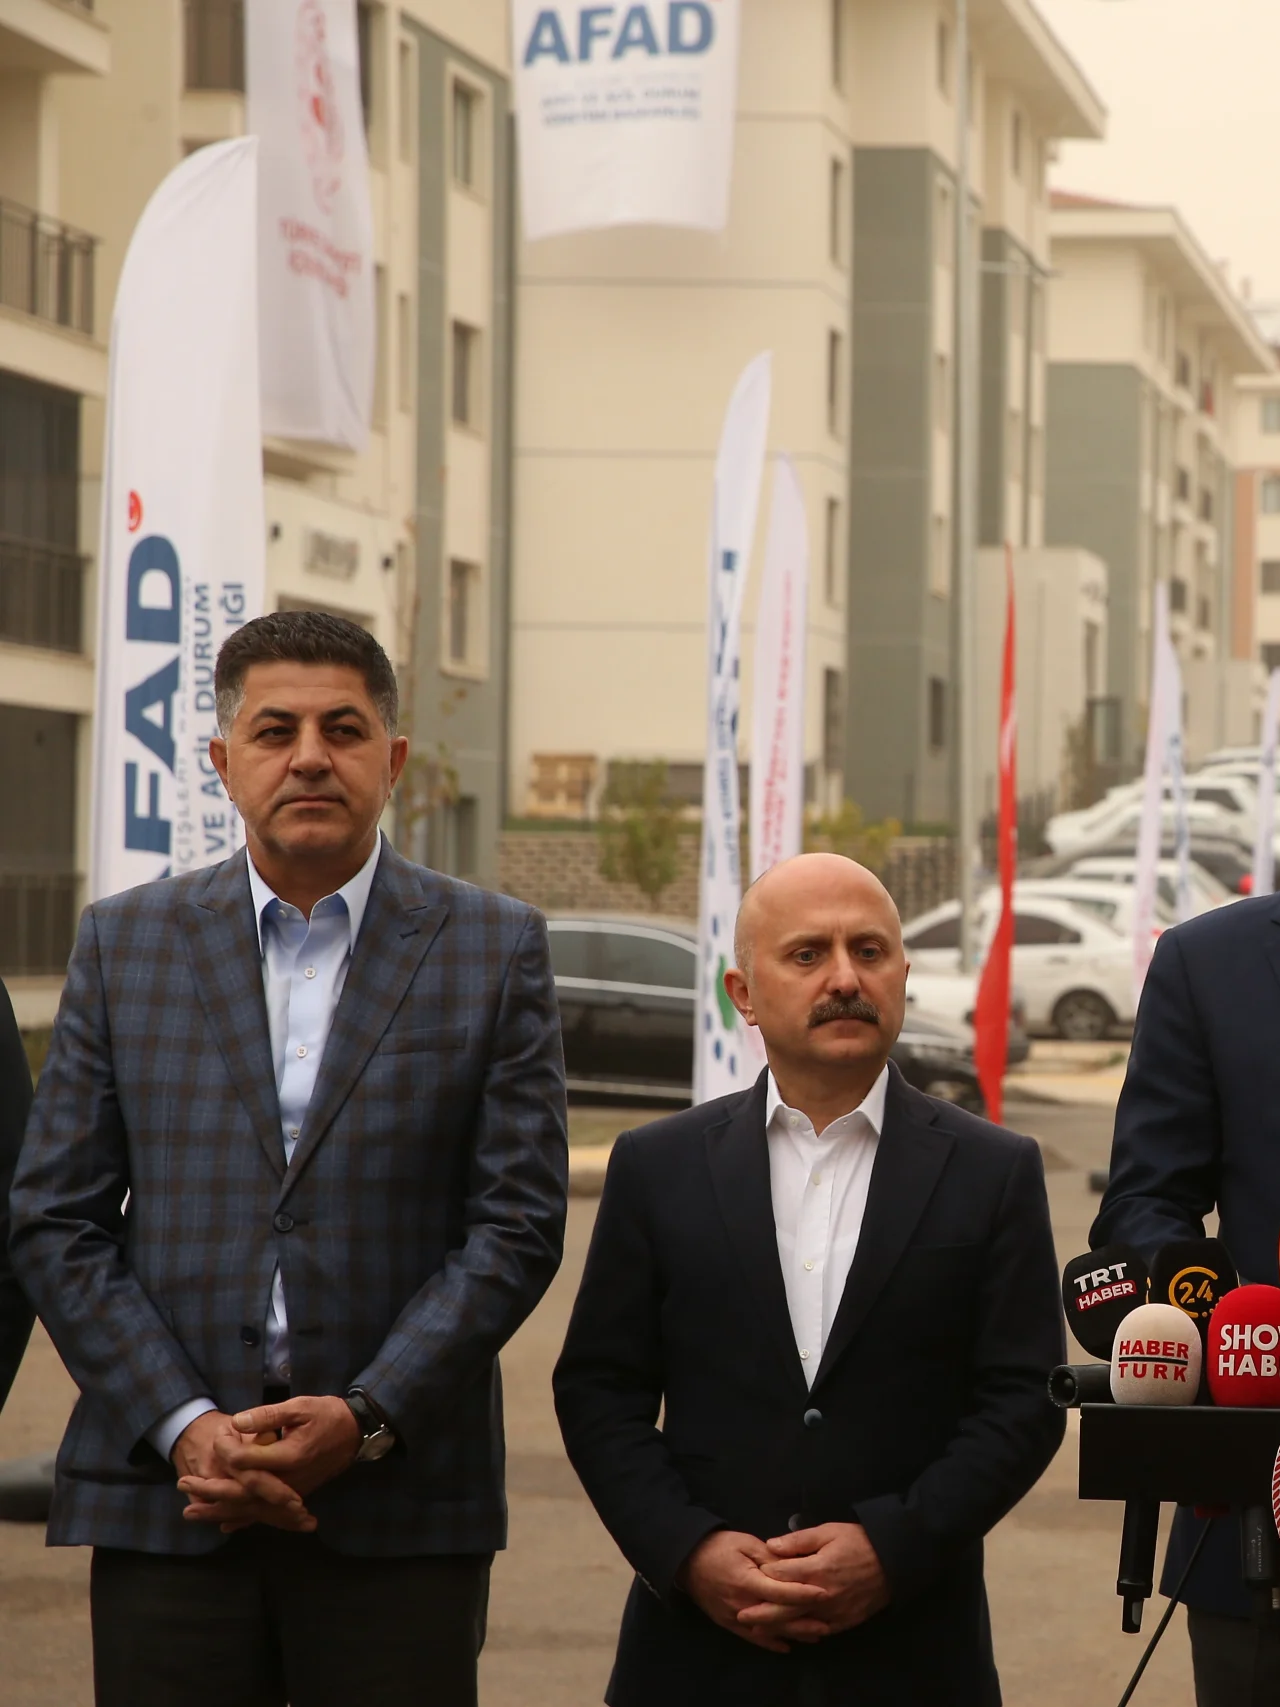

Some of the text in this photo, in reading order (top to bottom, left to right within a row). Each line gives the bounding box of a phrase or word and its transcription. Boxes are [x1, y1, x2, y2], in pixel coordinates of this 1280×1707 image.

[524, 1, 715, 67] AFAD
[195, 583, 216, 712] DURUM
[124, 534, 181, 879] FAD
[203, 813, 226, 855] VE
[1074, 1263, 1127, 1293] TRT
[1178, 1280, 1213, 1304] 24
[1078, 1281, 1134, 1310] HABER
[1119, 1340, 1189, 1359] HABER
[1118, 1363, 1187, 1383] TURK
